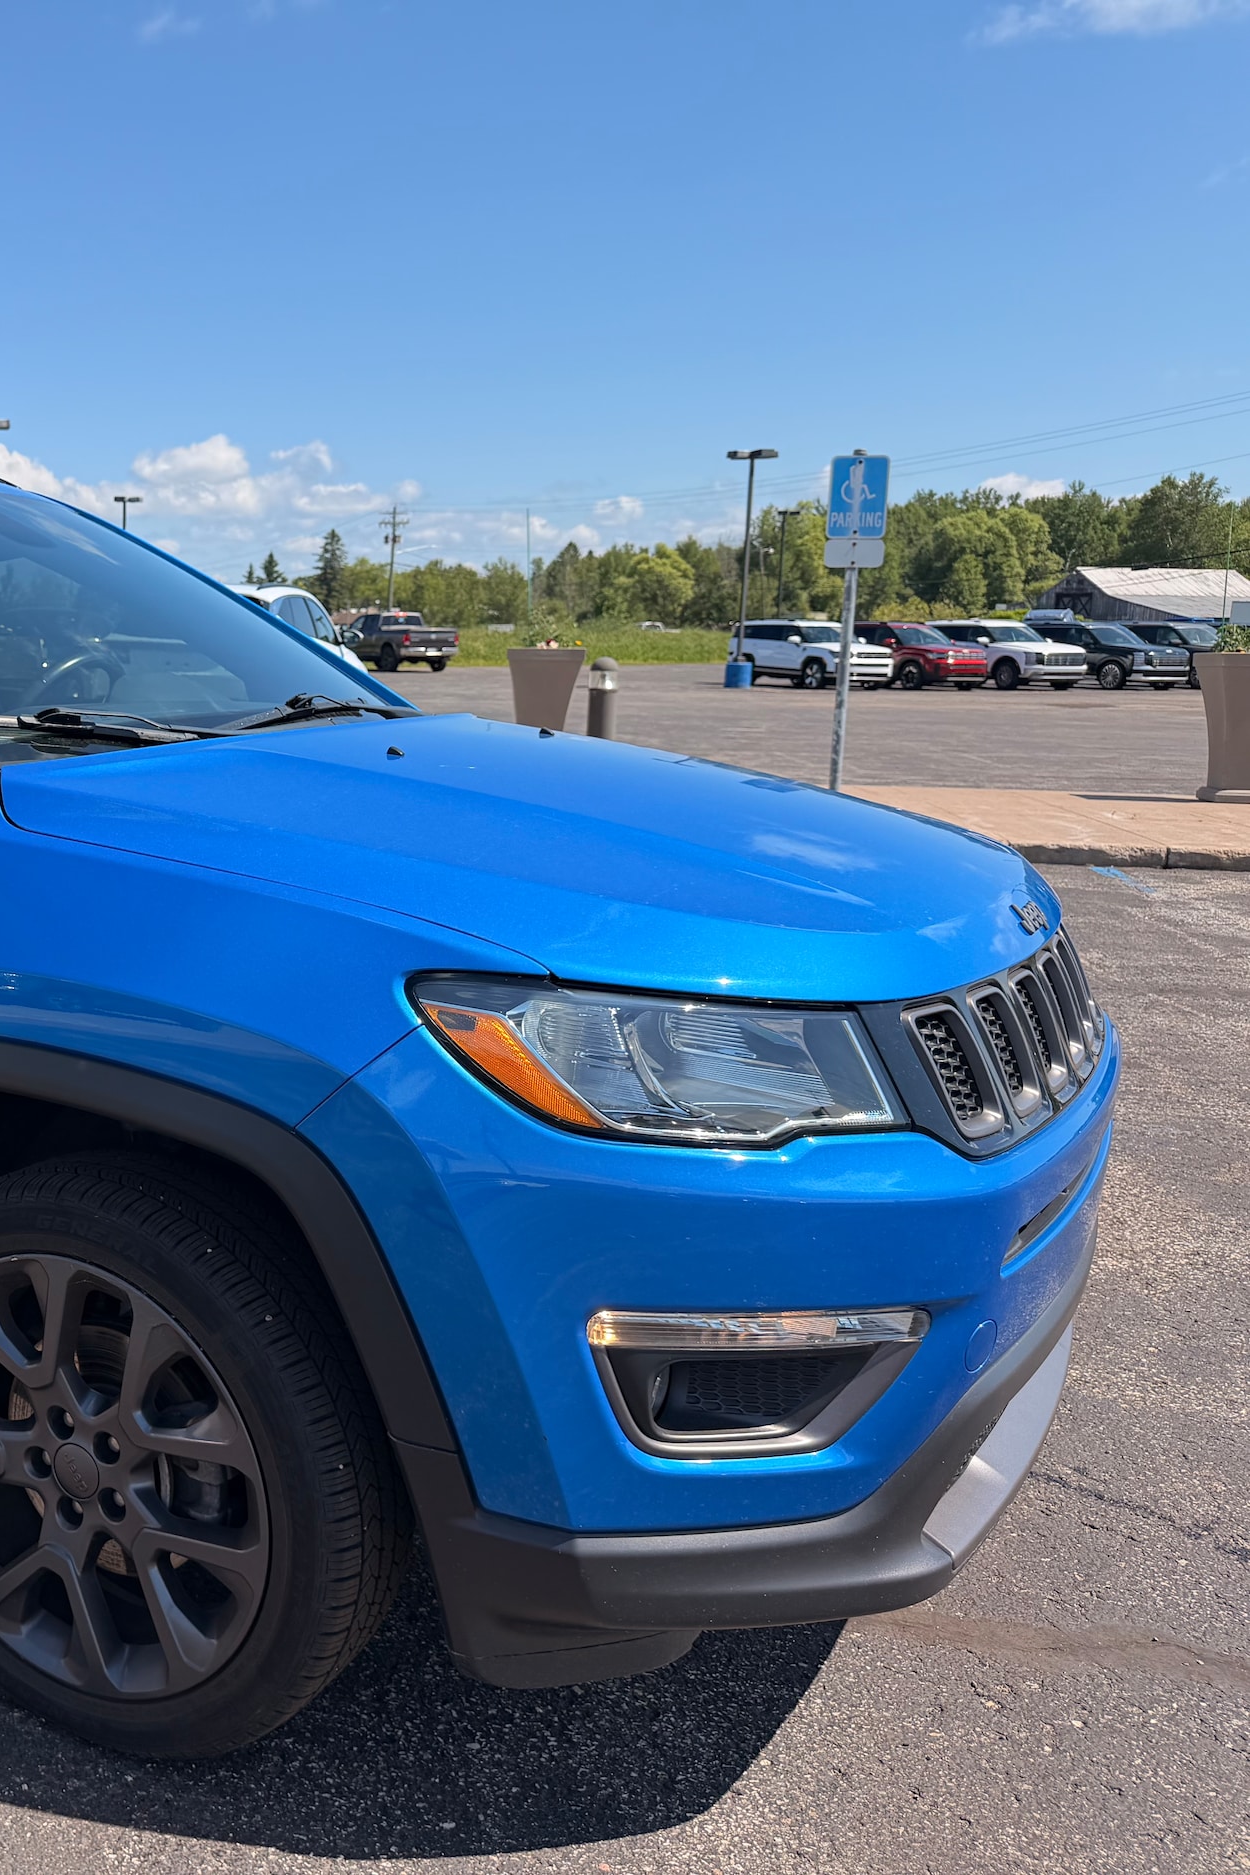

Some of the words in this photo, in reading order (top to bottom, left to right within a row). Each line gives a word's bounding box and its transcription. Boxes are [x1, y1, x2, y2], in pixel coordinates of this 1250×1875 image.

[830, 511, 882, 528] PARKING
[1009, 901, 1049, 935] Jeep
[34, 1213, 158, 1274] GENERAL
[63, 1452, 88, 1493] Jeep
